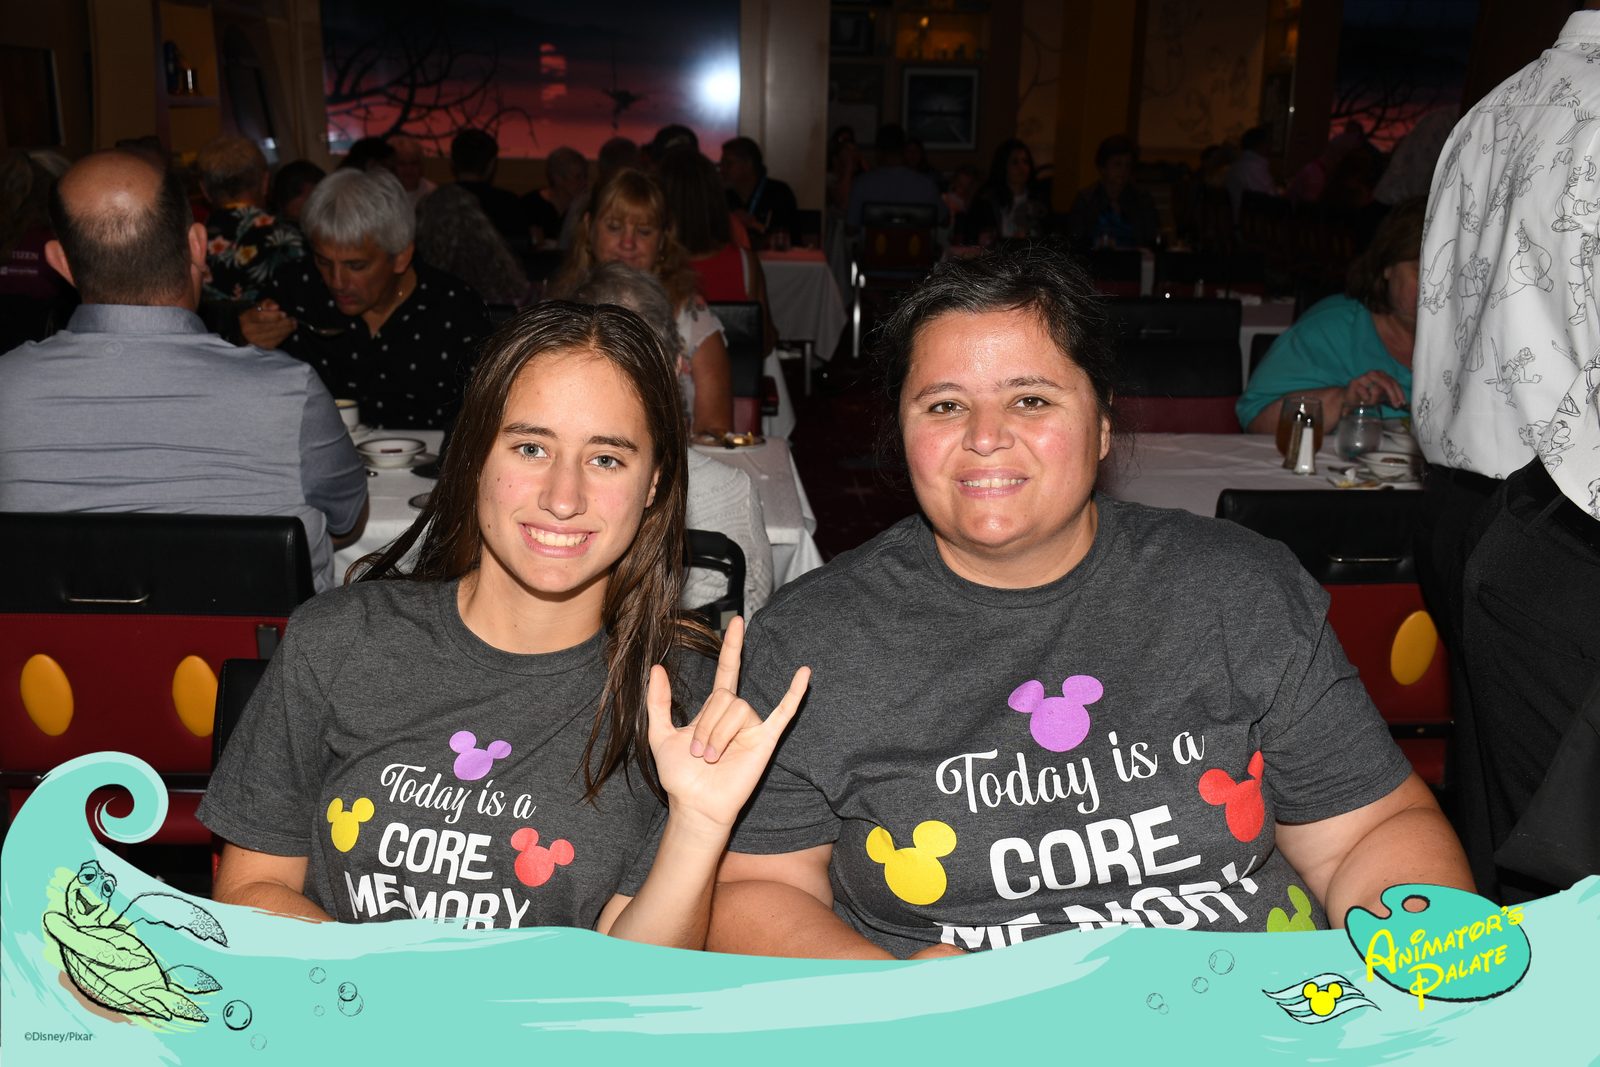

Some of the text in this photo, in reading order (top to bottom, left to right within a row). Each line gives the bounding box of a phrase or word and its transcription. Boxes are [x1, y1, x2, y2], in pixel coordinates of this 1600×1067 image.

[380, 763, 537, 824] Today is a
[935, 730, 1205, 814] Today is a
[378, 822, 494, 885] CORE
[989, 804, 1201, 901] CORE
